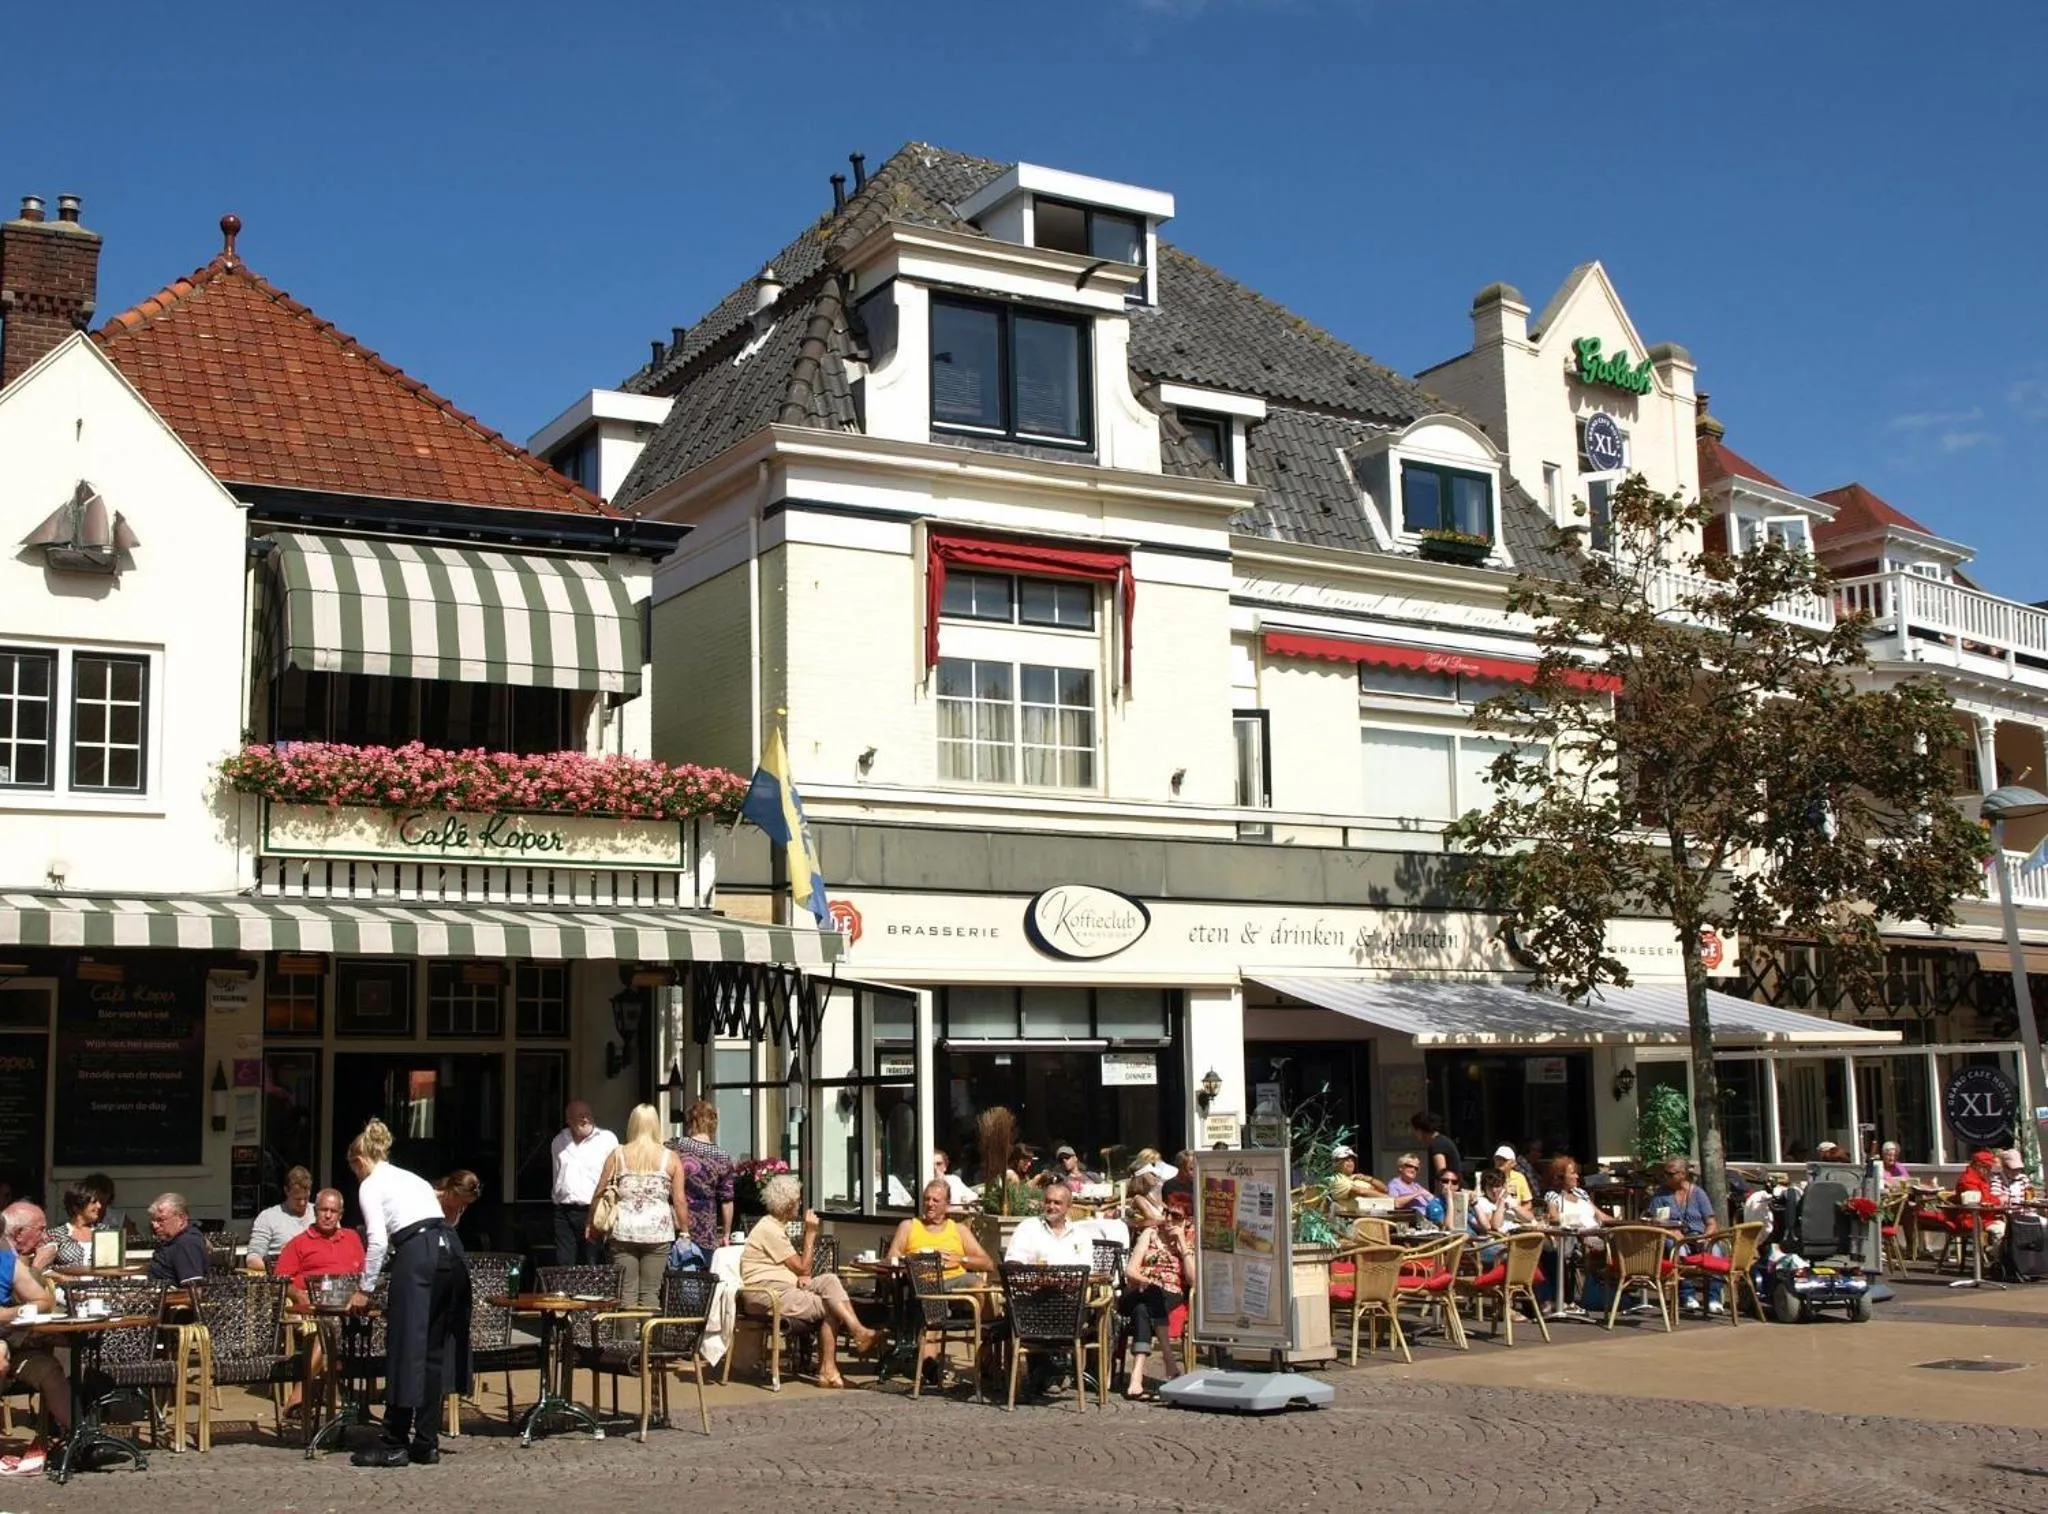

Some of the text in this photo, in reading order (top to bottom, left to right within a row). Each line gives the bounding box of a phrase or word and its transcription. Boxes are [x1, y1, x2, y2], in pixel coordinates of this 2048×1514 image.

[1573, 337, 1653, 396] Grolsch
[1594, 432, 1617, 456] XL
[401, 813, 564, 856] Café Koper
[886, 924, 1000, 938] BRASSERIE
[1041, 890, 1137, 948] Koffieclub
[1188, 916, 1459, 957] eten & drinken & genieten
[1608, 946, 1680, 957] RASSERI
[1124, 1072, 1152, 1081] DINNER
[1959, 1092, 2003, 1117] XL
